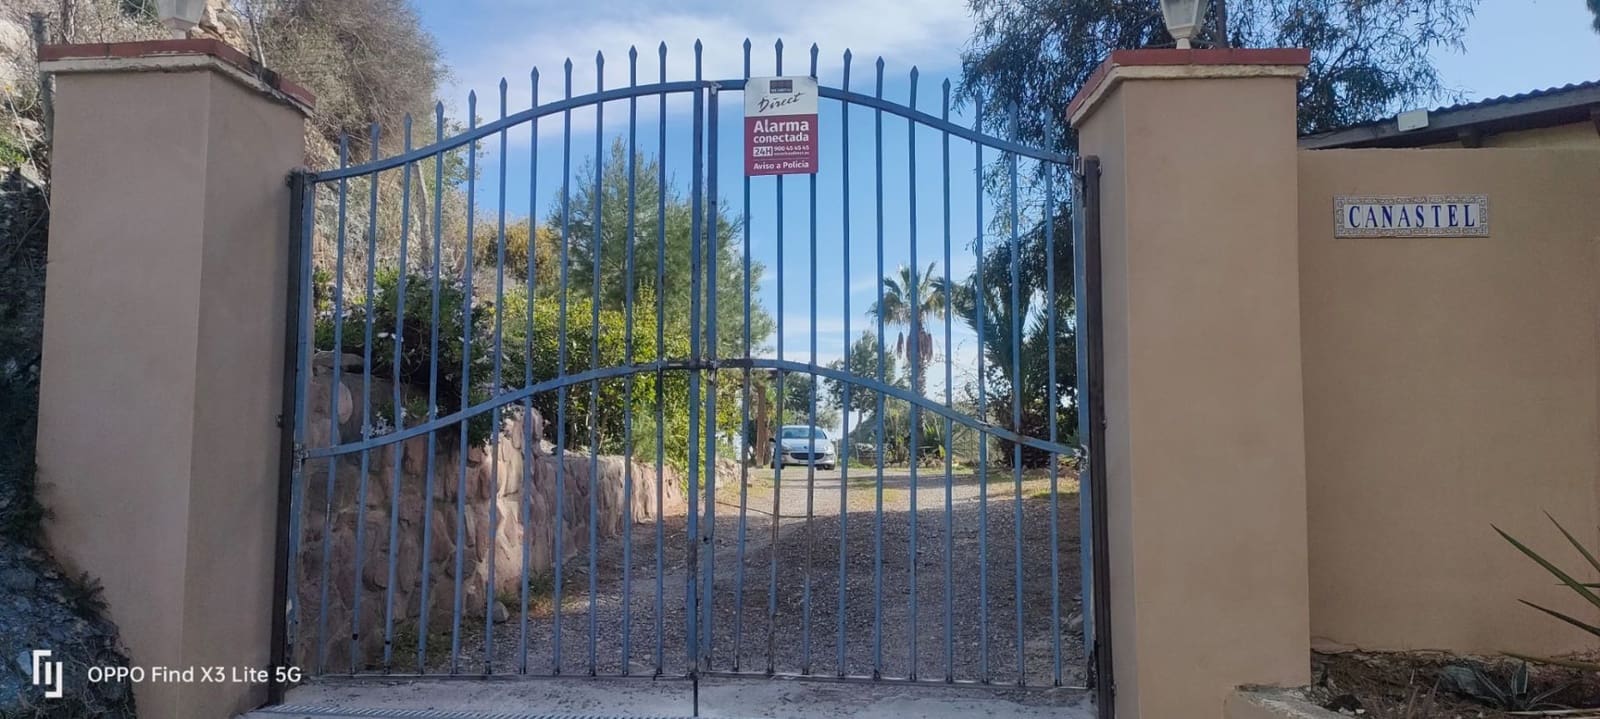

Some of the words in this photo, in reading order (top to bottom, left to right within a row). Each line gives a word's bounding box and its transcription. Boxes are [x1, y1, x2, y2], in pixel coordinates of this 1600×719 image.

[753, 119, 809, 133] Alarma
[753, 132, 809, 144] conectada
[754, 147, 772, 156] 24H
[753, 162, 775, 170] Aviso
[1348, 204, 1475, 228] CANASTEL
